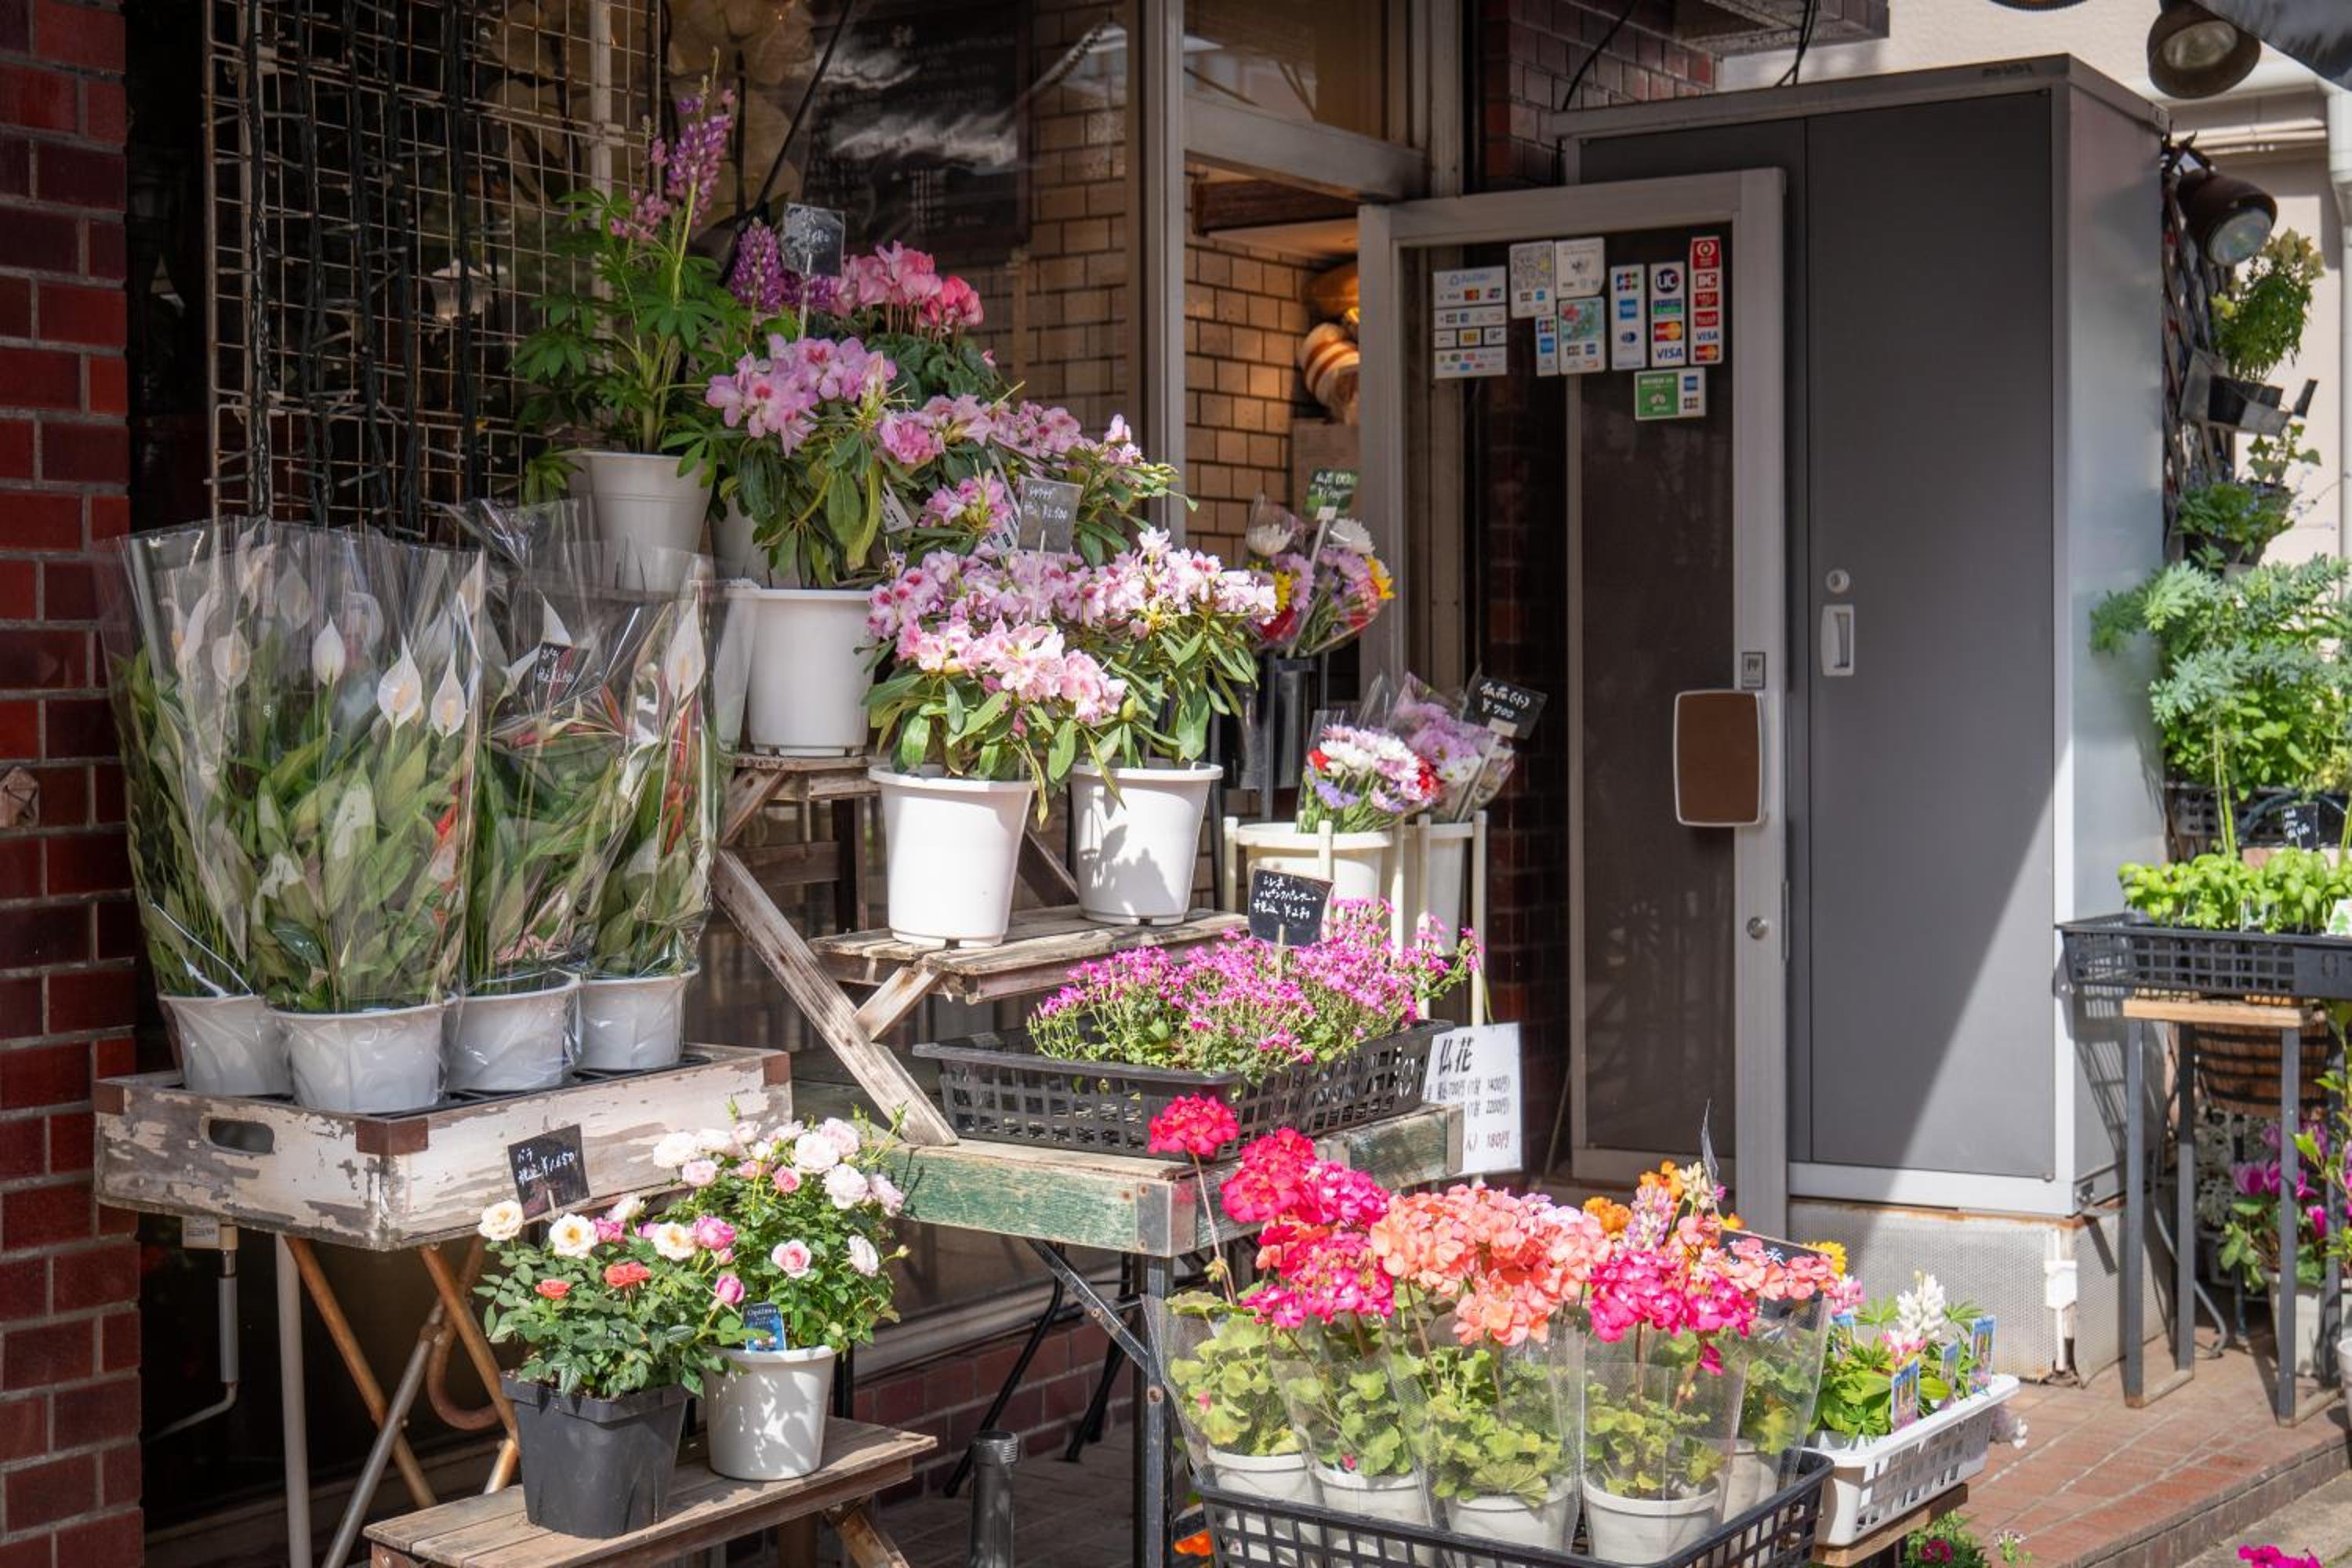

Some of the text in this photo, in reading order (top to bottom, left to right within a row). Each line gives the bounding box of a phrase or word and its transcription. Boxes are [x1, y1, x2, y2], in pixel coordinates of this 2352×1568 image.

[1697, 330, 1719, 342] VISA
[1656, 347, 1684, 360] VISA
[1438, 1035, 1474, 1076] 仏花
